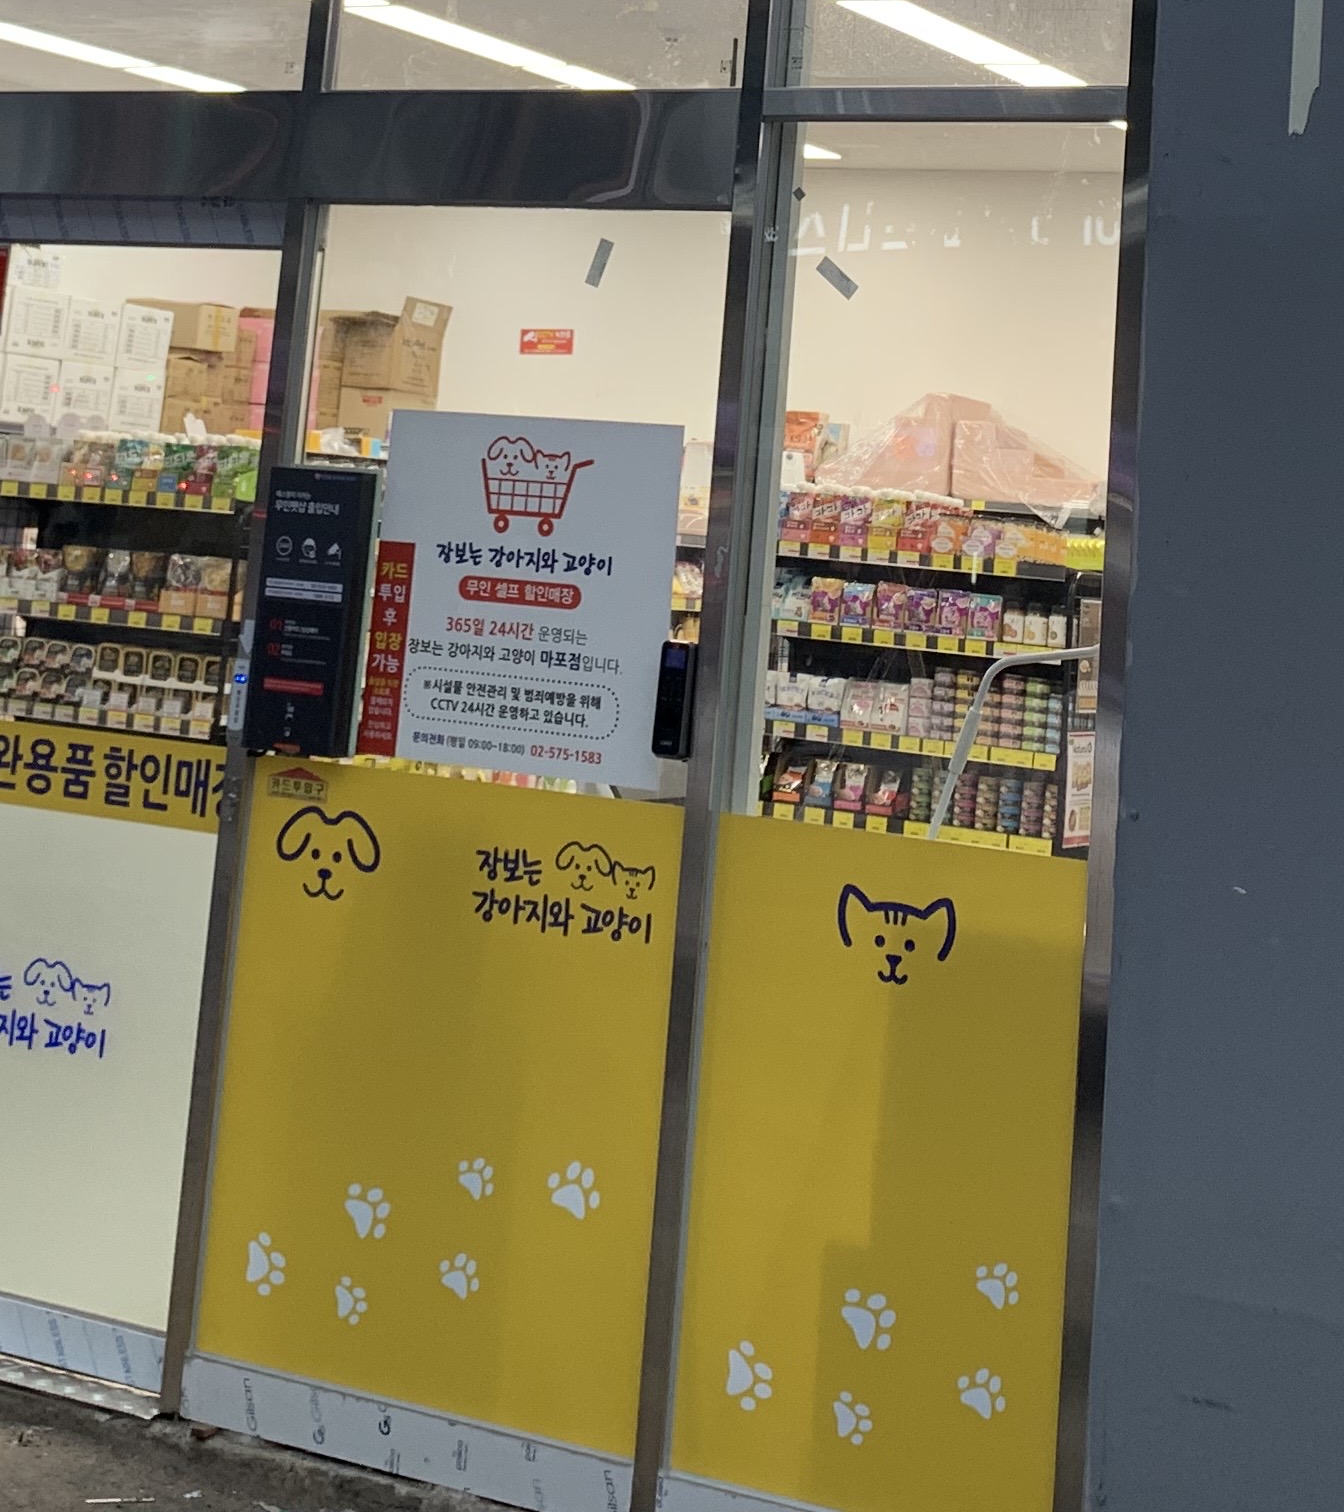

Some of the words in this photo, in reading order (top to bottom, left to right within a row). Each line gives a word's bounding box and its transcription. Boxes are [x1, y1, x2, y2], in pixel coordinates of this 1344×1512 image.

[380, 562, 409, 580] 카드
[436, 541, 484, 566] 장보는
[488, 545, 559, 575] 강아지와
[562, 551, 614, 577] 고양이
[378, 583, 407, 604] 투입
[466, 579, 492, 598] 무인
[494, 582, 520, 599] 셀프
[524, 584, 575, 605] 할인매장
[382, 607, 398, 627] 후
[445, 616, 486, 637] 365일
[489, 620, 534, 642] 24시간
[537, 625, 589, 647] 운영되는
[374, 630, 403, 652] 입장
[371, 652, 401, 674] 가능
[407, 638, 444, 656] 장보는
[447, 642, 496, 662] 강아지와
[498, 647, 536, 666] 고양이
[540, 650, 624, 676] 마포점입니다.
[465, 681, 508, 701] 안전관리
[523, 688, 577, 709] 범죄예방을
[579, 694, 602, 711] 위해
[430, 697, 460, 713] CCTV
[460, 700, 496, 718] 24시간
[497, 704, 541, 722] 운영하고
[542, 708, 590, 729] 있습니다.
[529, 743, 604, 766] 02-575-1583
[475, 846, 543, 886] 장보는
[471, 889, 575, 937] 강아지와
[579, 902, 653, 944] 고양이
[43, 1017, 108, 1059] 고양이
